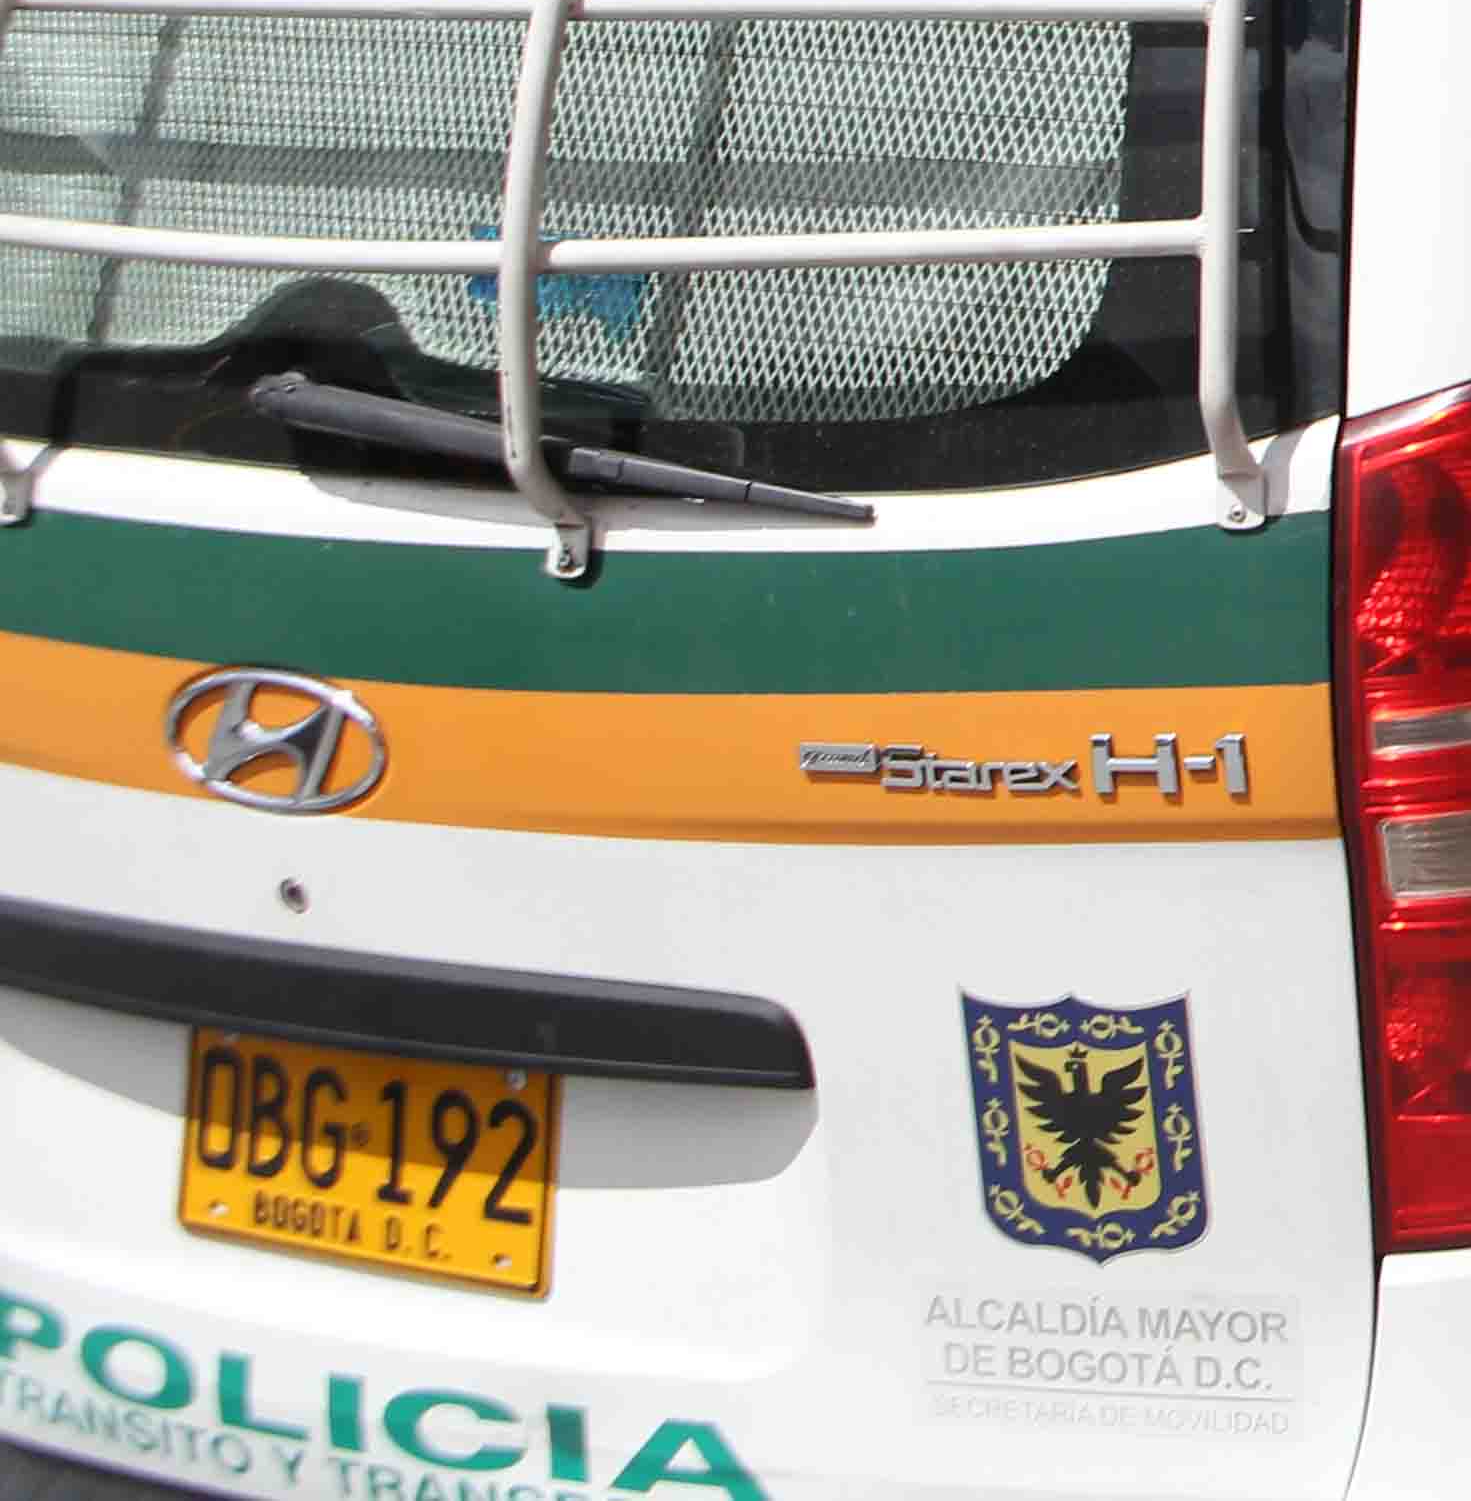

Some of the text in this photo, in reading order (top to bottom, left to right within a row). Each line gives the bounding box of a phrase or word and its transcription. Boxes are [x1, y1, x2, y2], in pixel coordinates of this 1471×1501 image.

[880, 744, 1082, 792] Starex
[1089, 732, 1249, 795] H-1
[251, 1191, 455, 1263] BOGOTA D.C.
[924, 1294, 1290, 1346] ALCALDÍA MAYOR
[943, 1341, 1274, 1392] DE BOGOTÁ D.C.
[0, 1288, 780, 1501] POLICIA
[1099, 1404, 1137, 1429] DE
[273, 1442, 305, 1486] Y
